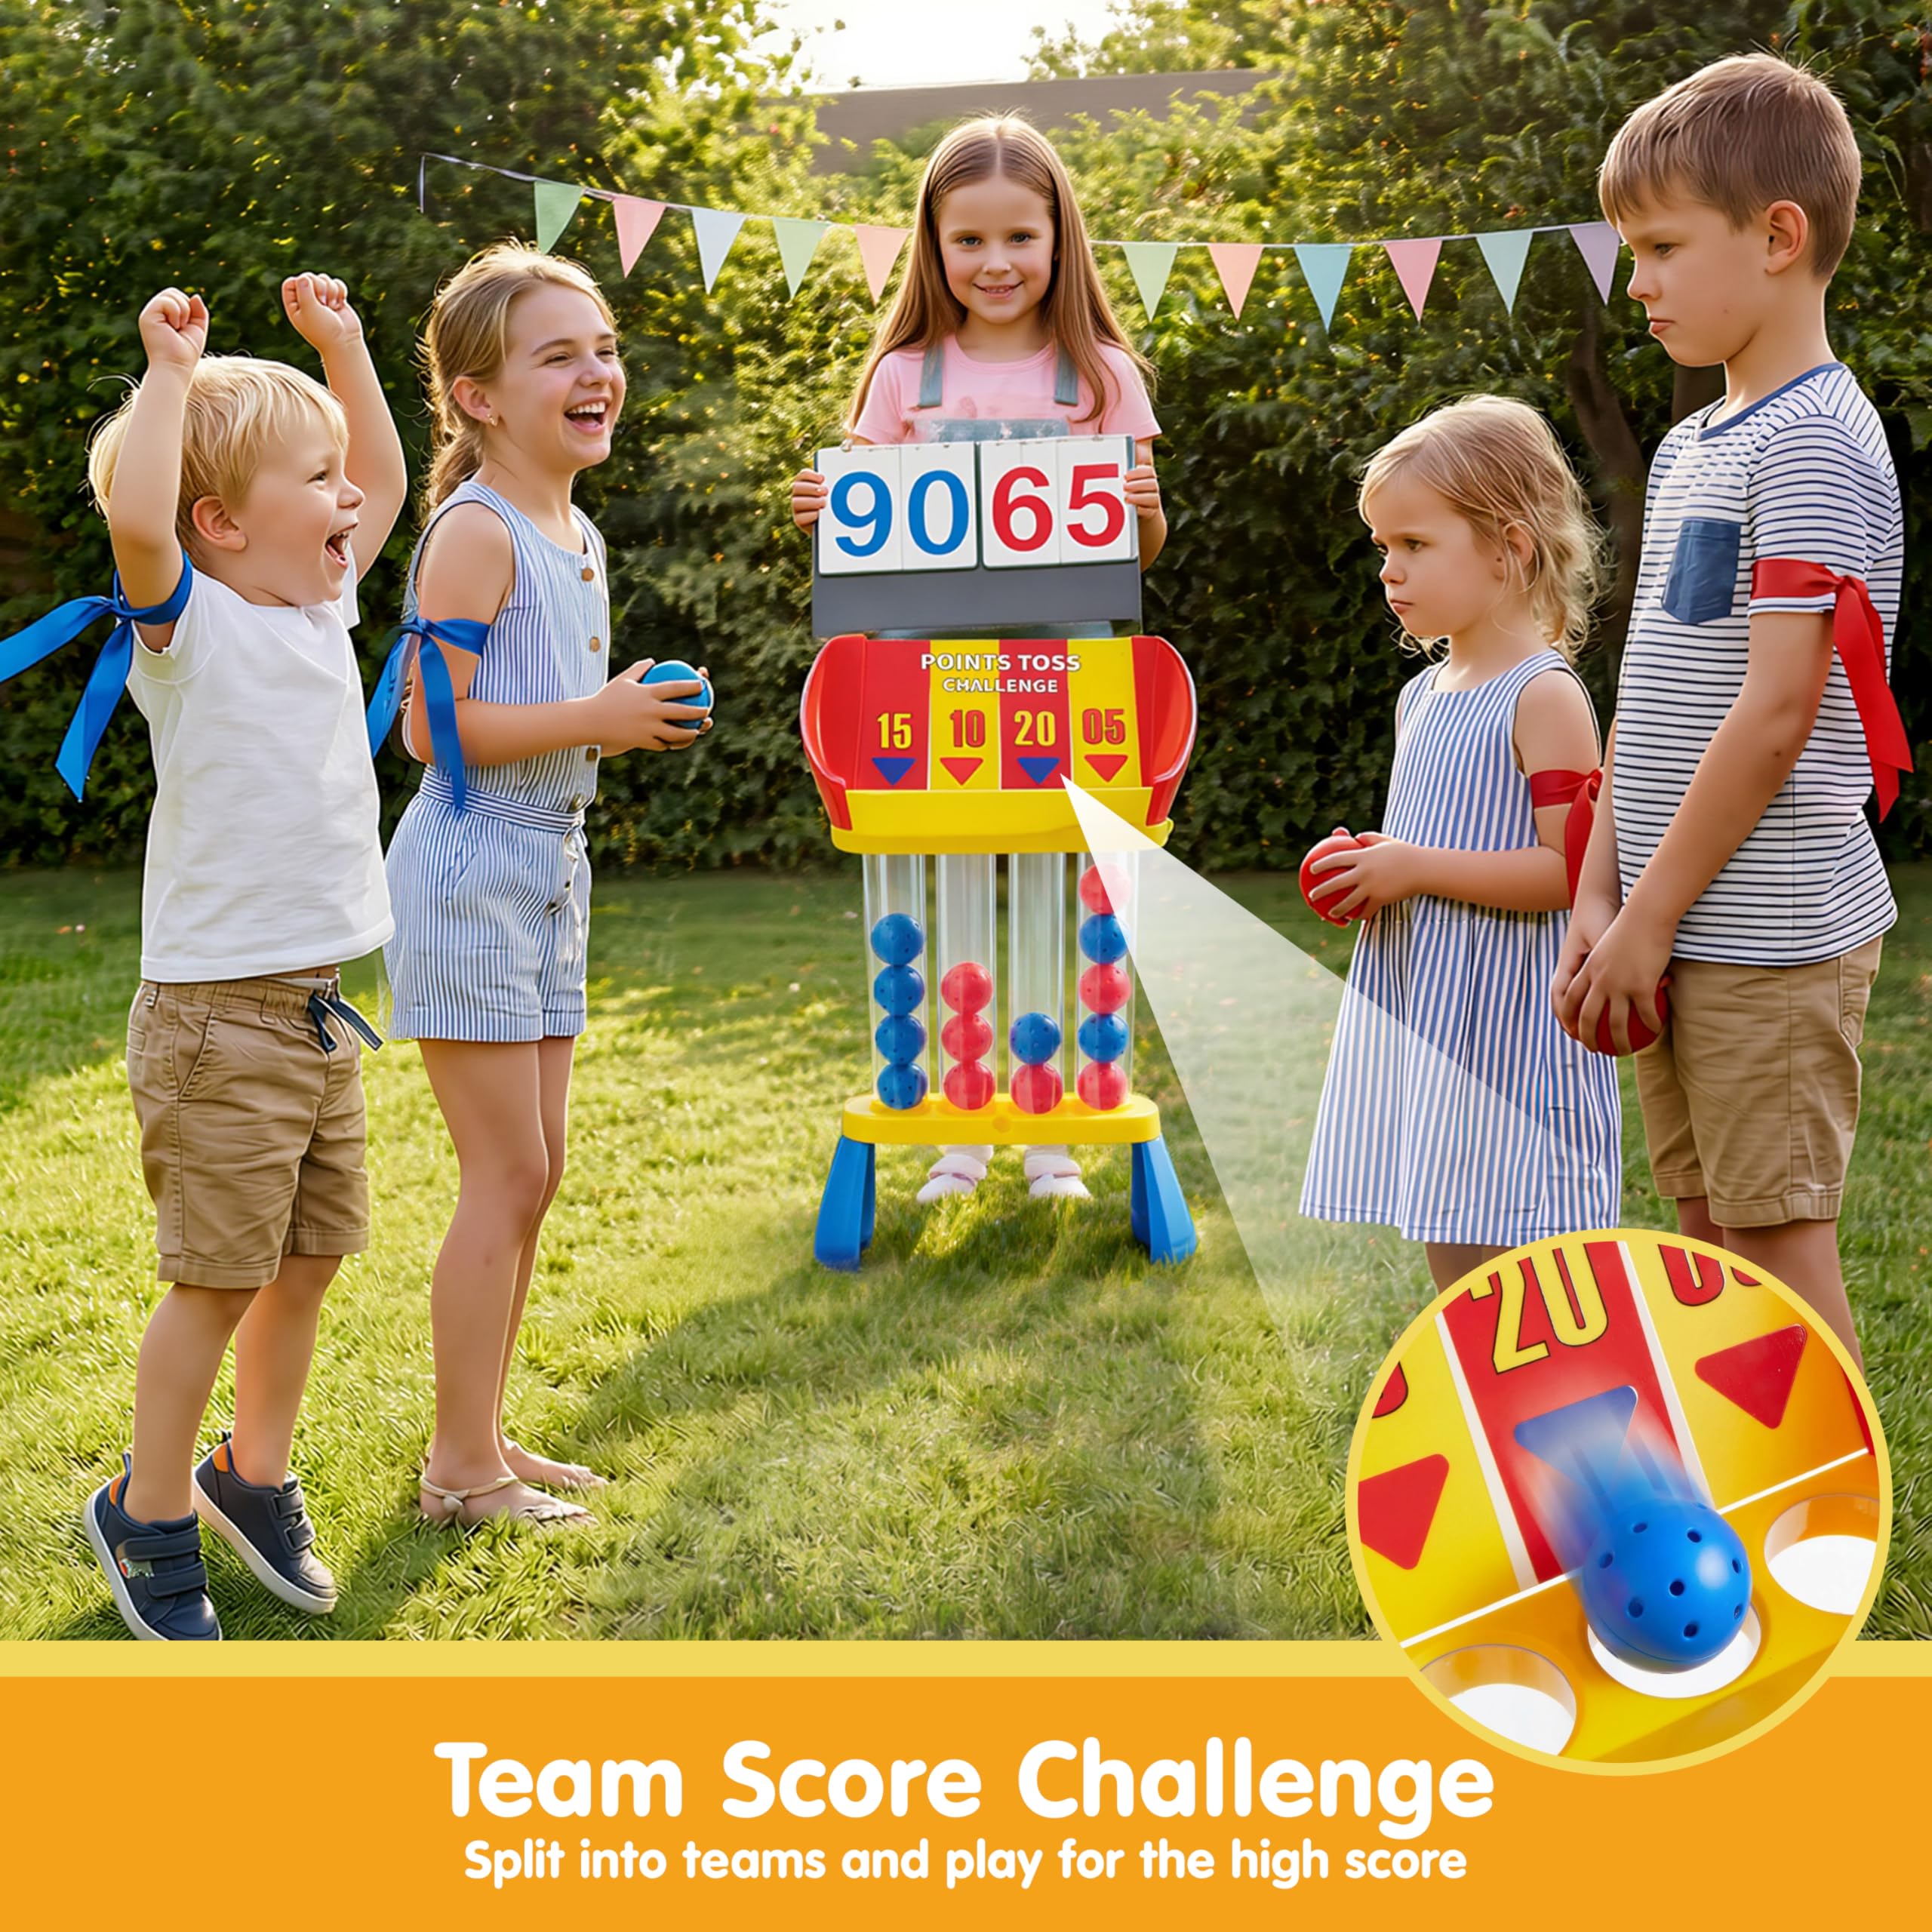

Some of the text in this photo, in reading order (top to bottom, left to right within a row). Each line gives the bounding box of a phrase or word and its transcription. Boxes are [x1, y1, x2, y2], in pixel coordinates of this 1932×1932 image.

[829, 463, 1126, 558] 90 65
[921, 653, 1081, 672] POINTS TOSS
[943, 677, 1059, 693] CHALLENGE
[876, 708, 1127, 749] 15 10 20 05
[1468, 1242, 1609, 1375] 20
